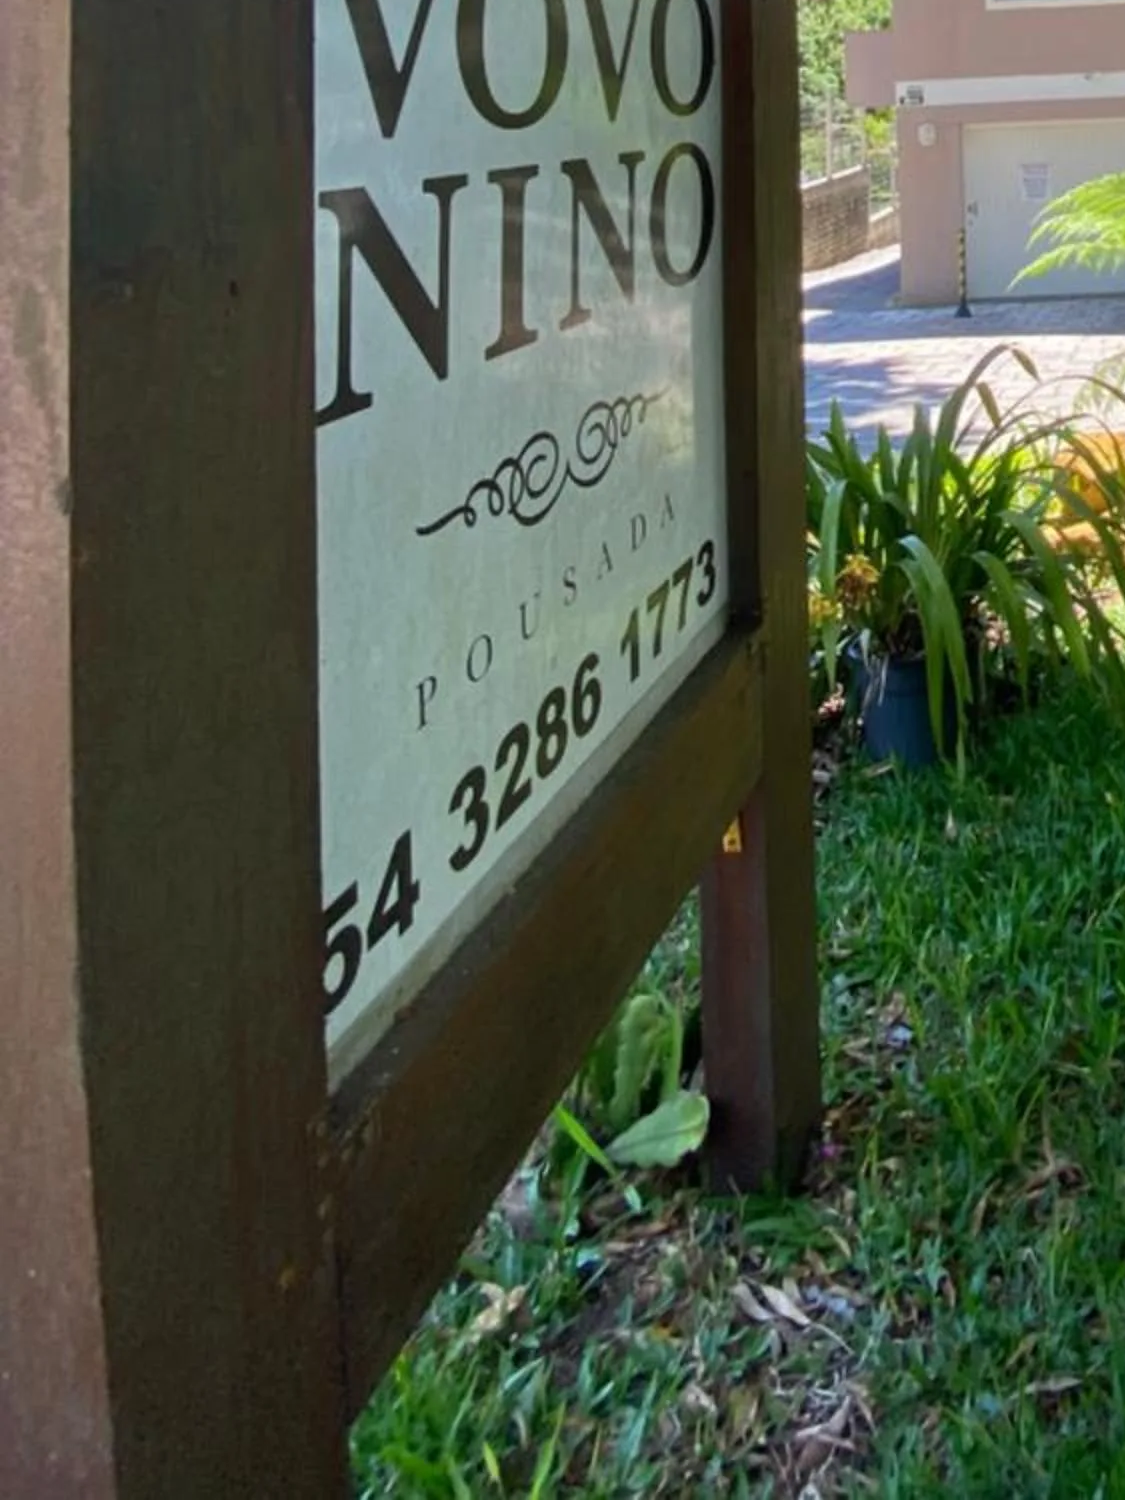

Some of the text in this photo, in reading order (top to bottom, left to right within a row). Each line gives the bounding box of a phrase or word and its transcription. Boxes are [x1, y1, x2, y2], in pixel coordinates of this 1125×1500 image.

[315, 141, 715, 427] NINO
[416, 494, 675, 730] POUSADA
[323, 540, 716, 1016] 54 3286 1773
